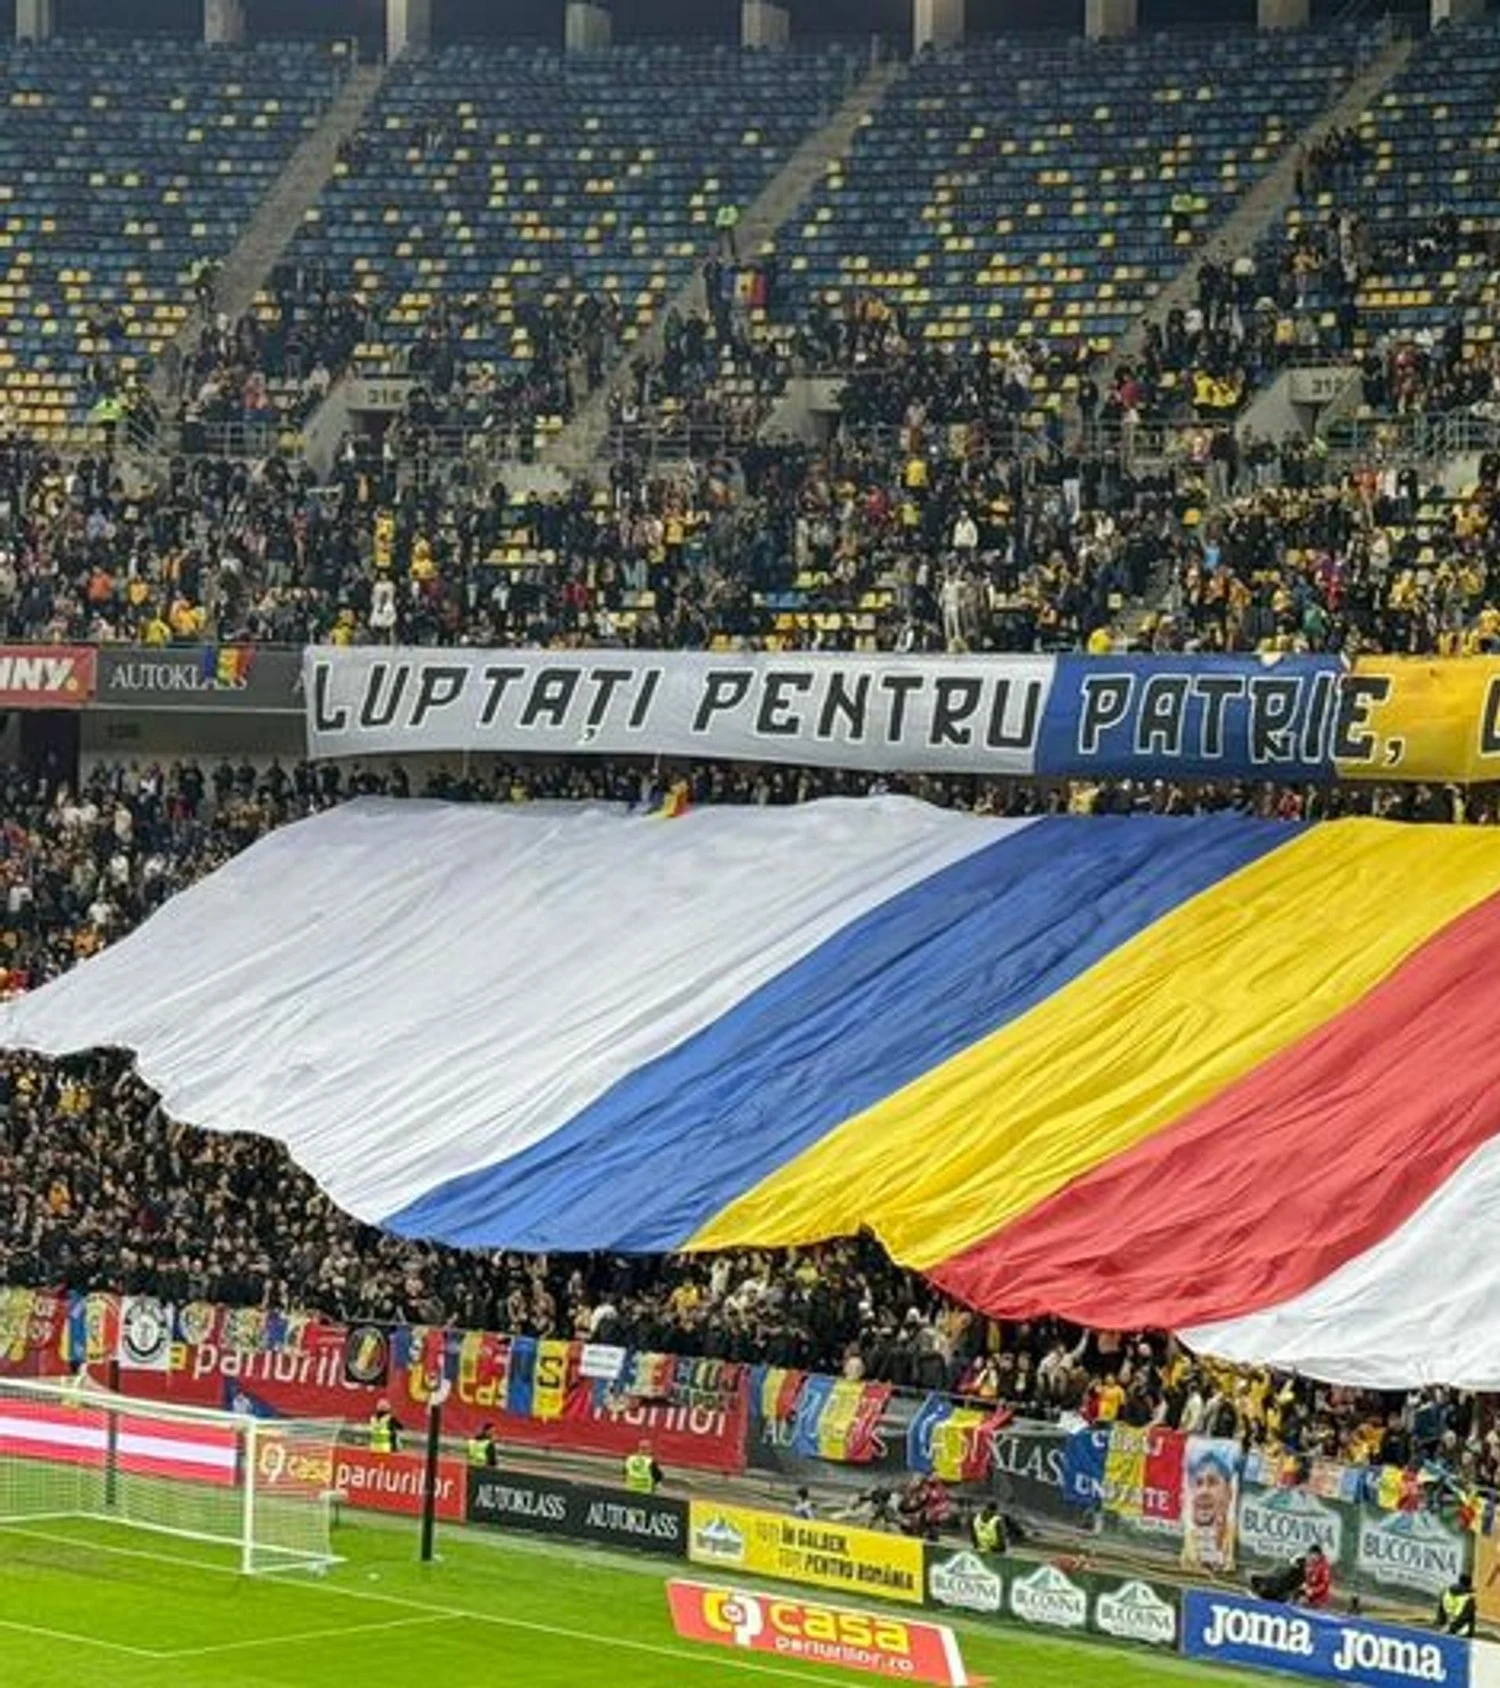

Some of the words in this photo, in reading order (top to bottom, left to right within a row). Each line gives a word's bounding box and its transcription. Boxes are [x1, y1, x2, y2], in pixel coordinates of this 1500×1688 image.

[314, 661, 663, 744] LUPTAȚI
[692, 668, 1042, 750] PENTRU
[1078, 671, 1406, 767] PATRIE,
[475, 1484, 567, 1520] AUTOKLASS
[585, 1502, 679, 1540] AUTOKLASS
[1244, 1506, 1335, 1550] BUCOVINA
[1363, 1530, 1458, 1576] BUCOVINA
[769, 1602, 910, 1653] casa
